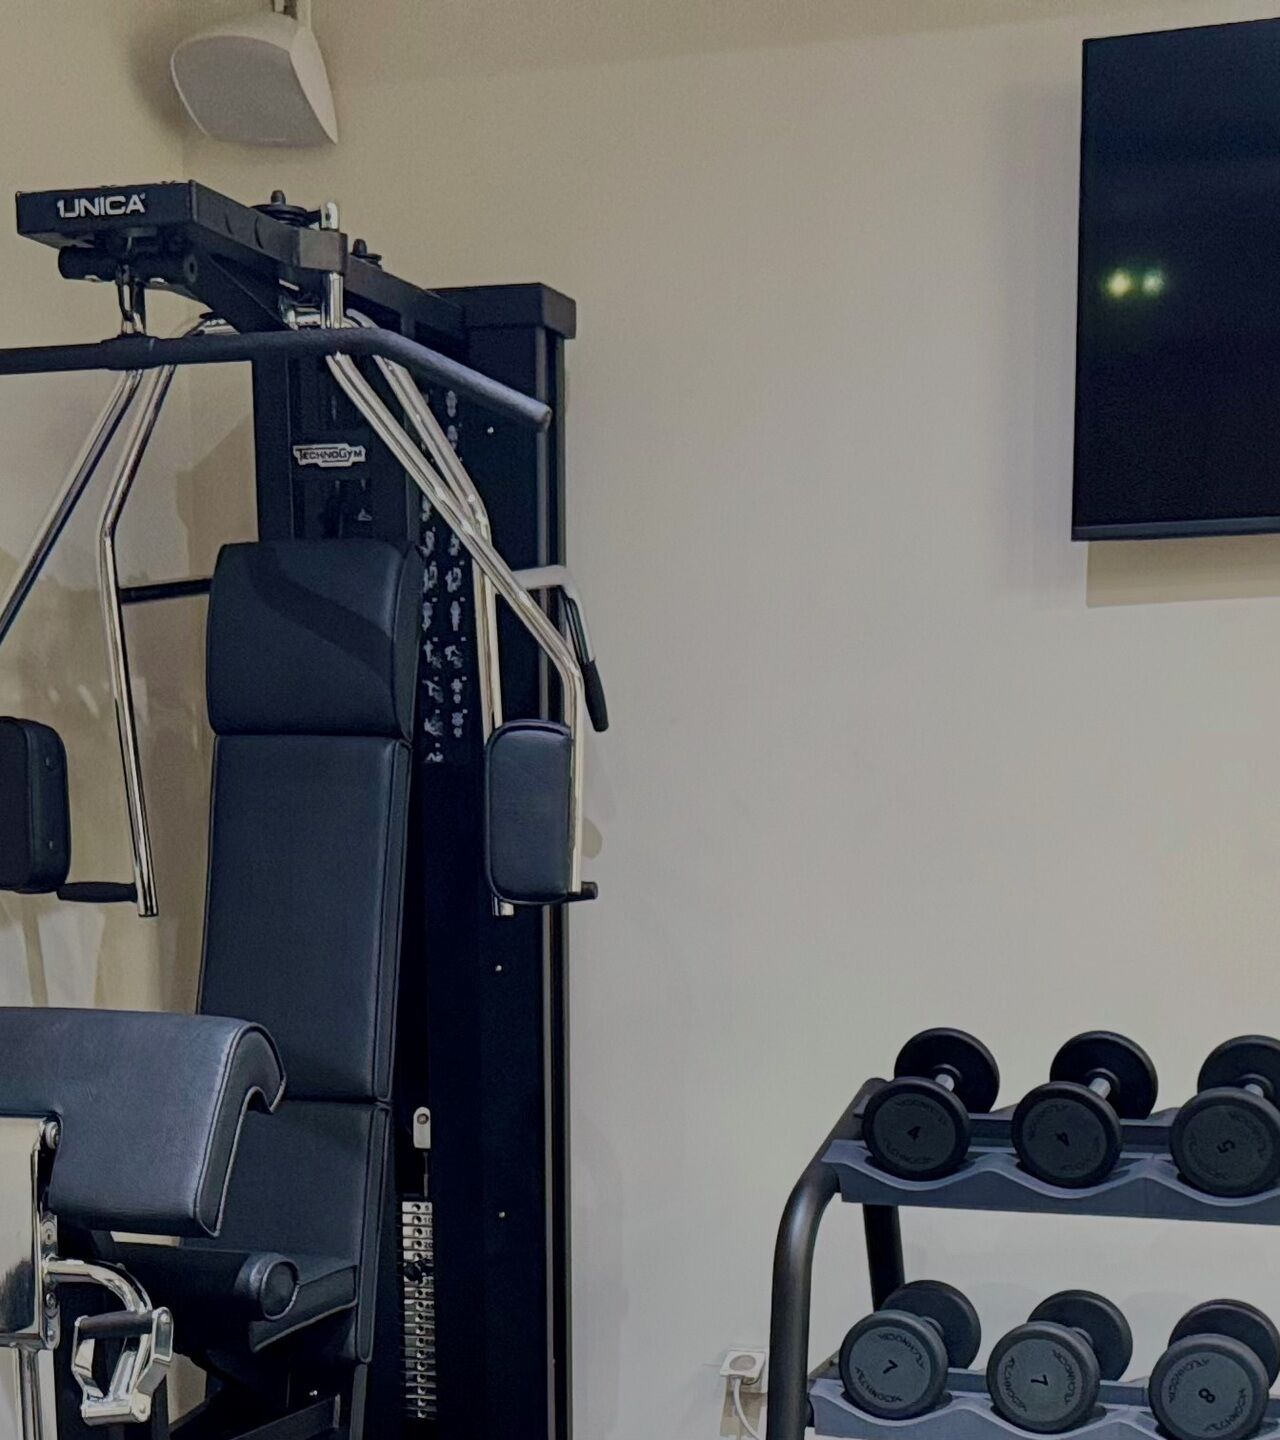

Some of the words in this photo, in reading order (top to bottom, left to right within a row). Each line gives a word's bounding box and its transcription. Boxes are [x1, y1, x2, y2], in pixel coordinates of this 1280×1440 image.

[56, 192, 146, 218] UNICA
[296, 446, 363, 463] TECHNOGYM
[906, 1125, 921, 1142] 4
[1056, 1131, 1071, 1148] 4
[1214, 1138, 1237, 1157] 5
[882, 1358, 900, 1377] 7
[1029, 1373, 1049, 1389] 7
[1197, 1386, 1217, 1406] 8
